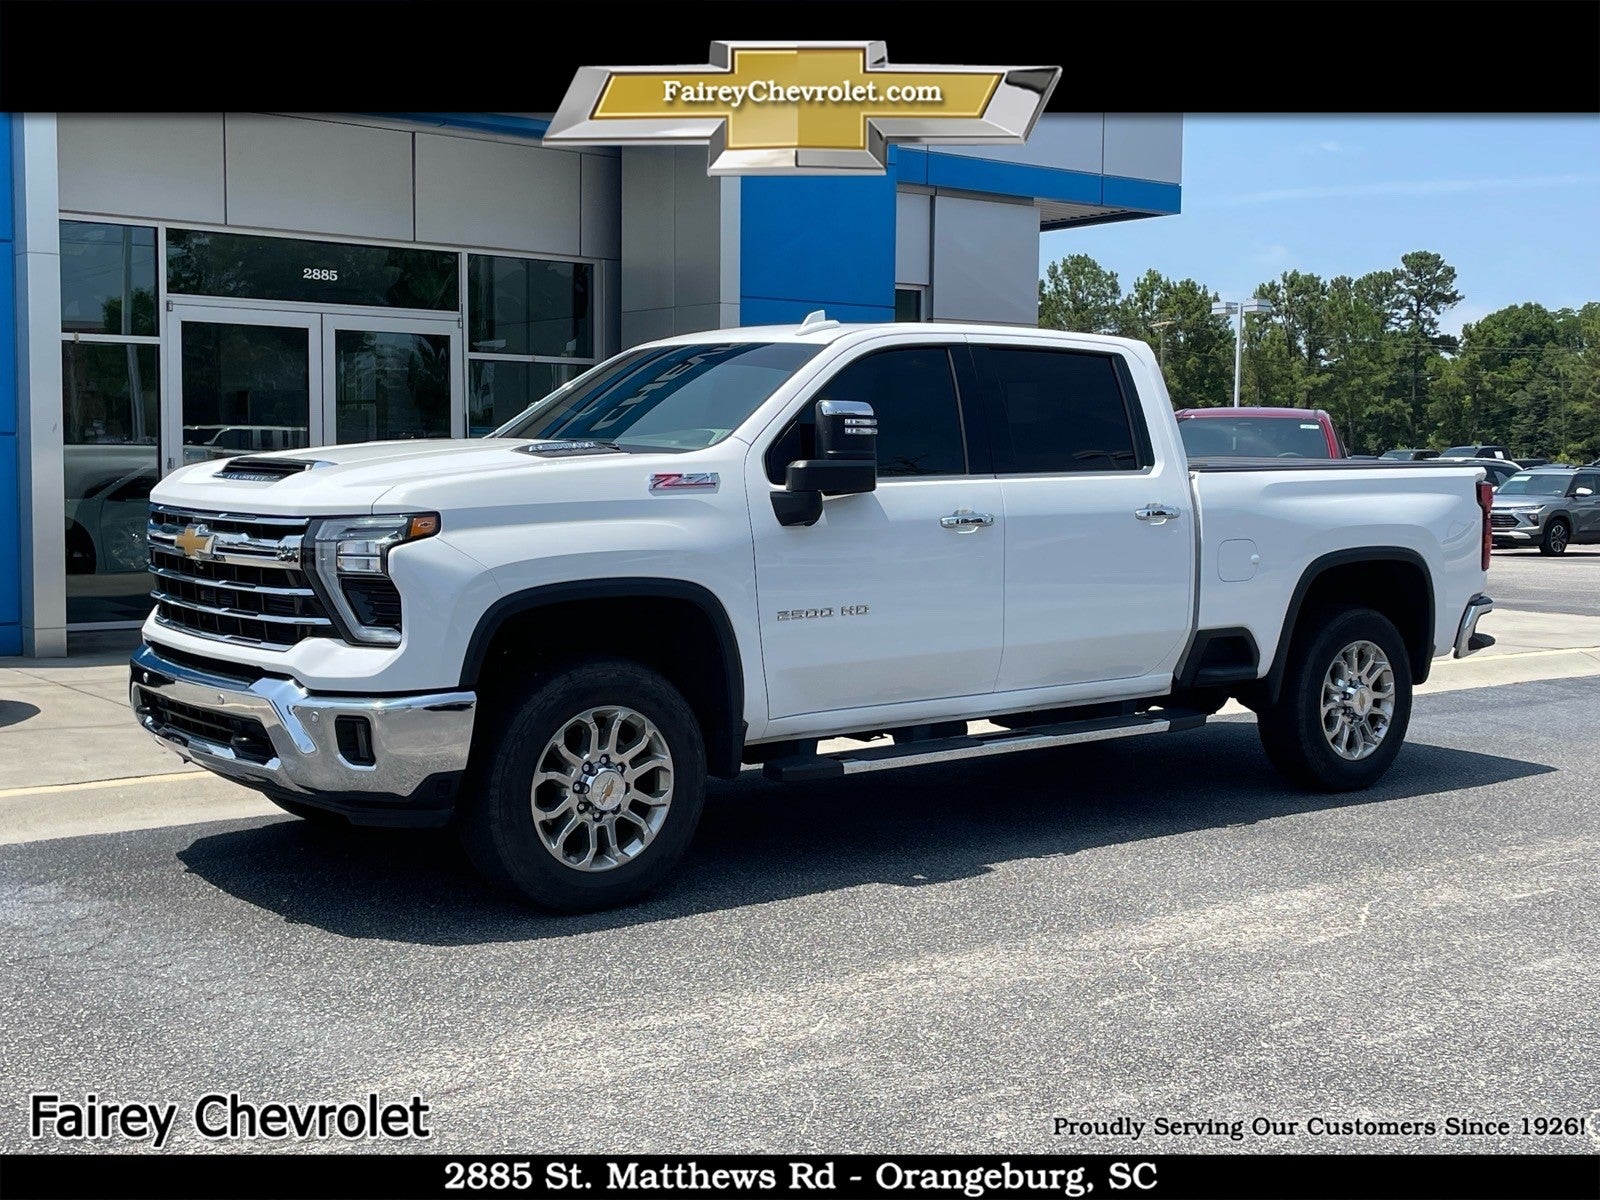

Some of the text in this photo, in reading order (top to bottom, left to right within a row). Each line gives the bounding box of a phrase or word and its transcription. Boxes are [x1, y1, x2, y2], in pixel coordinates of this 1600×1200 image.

[303, 267, 338, 281] 2885
[650, 473, 720, 491] Z71
[777, 604, 869, 621] 2500 HD
